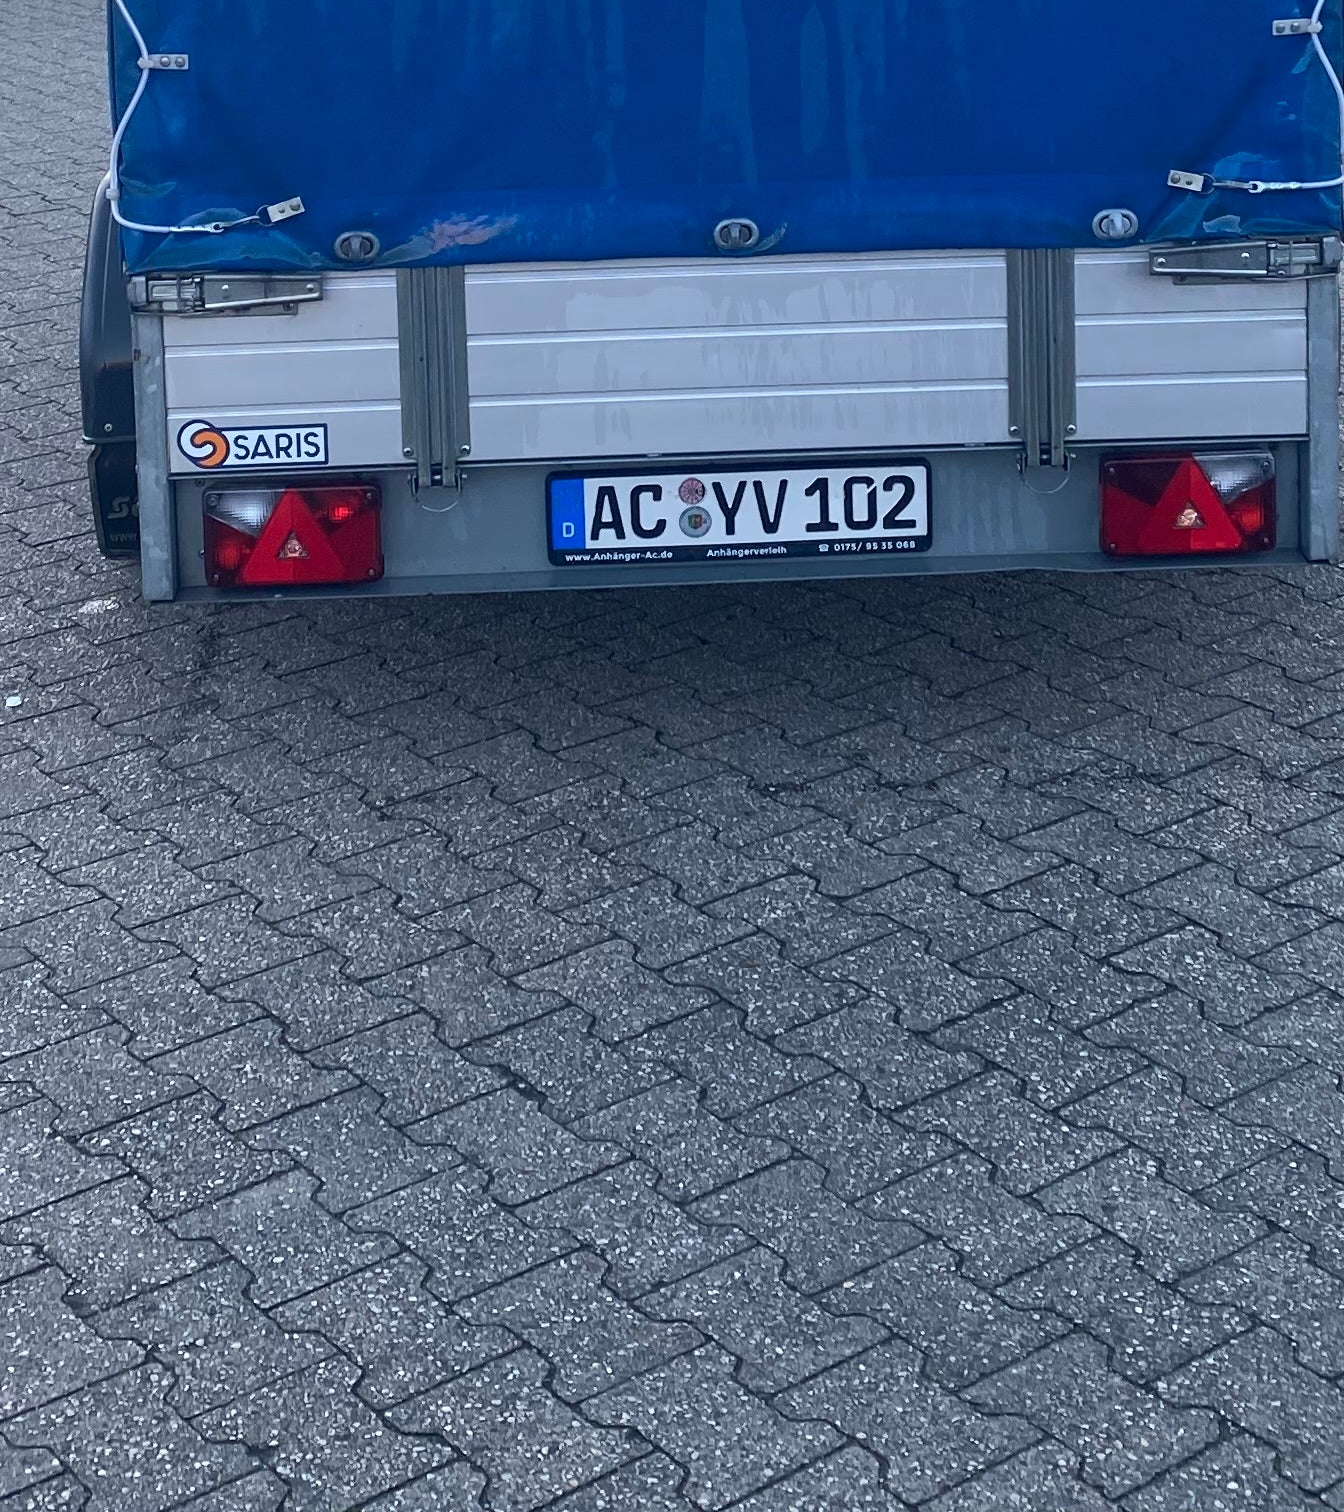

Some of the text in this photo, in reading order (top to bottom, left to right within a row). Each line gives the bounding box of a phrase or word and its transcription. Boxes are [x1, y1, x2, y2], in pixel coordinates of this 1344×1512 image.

[233, 431, 321, 461] SARIS
[590, 474, 917, 541] AC YV 102
[562, 521, 575, 538] D
[706, 546, 788, 558] Anhängerverleih
